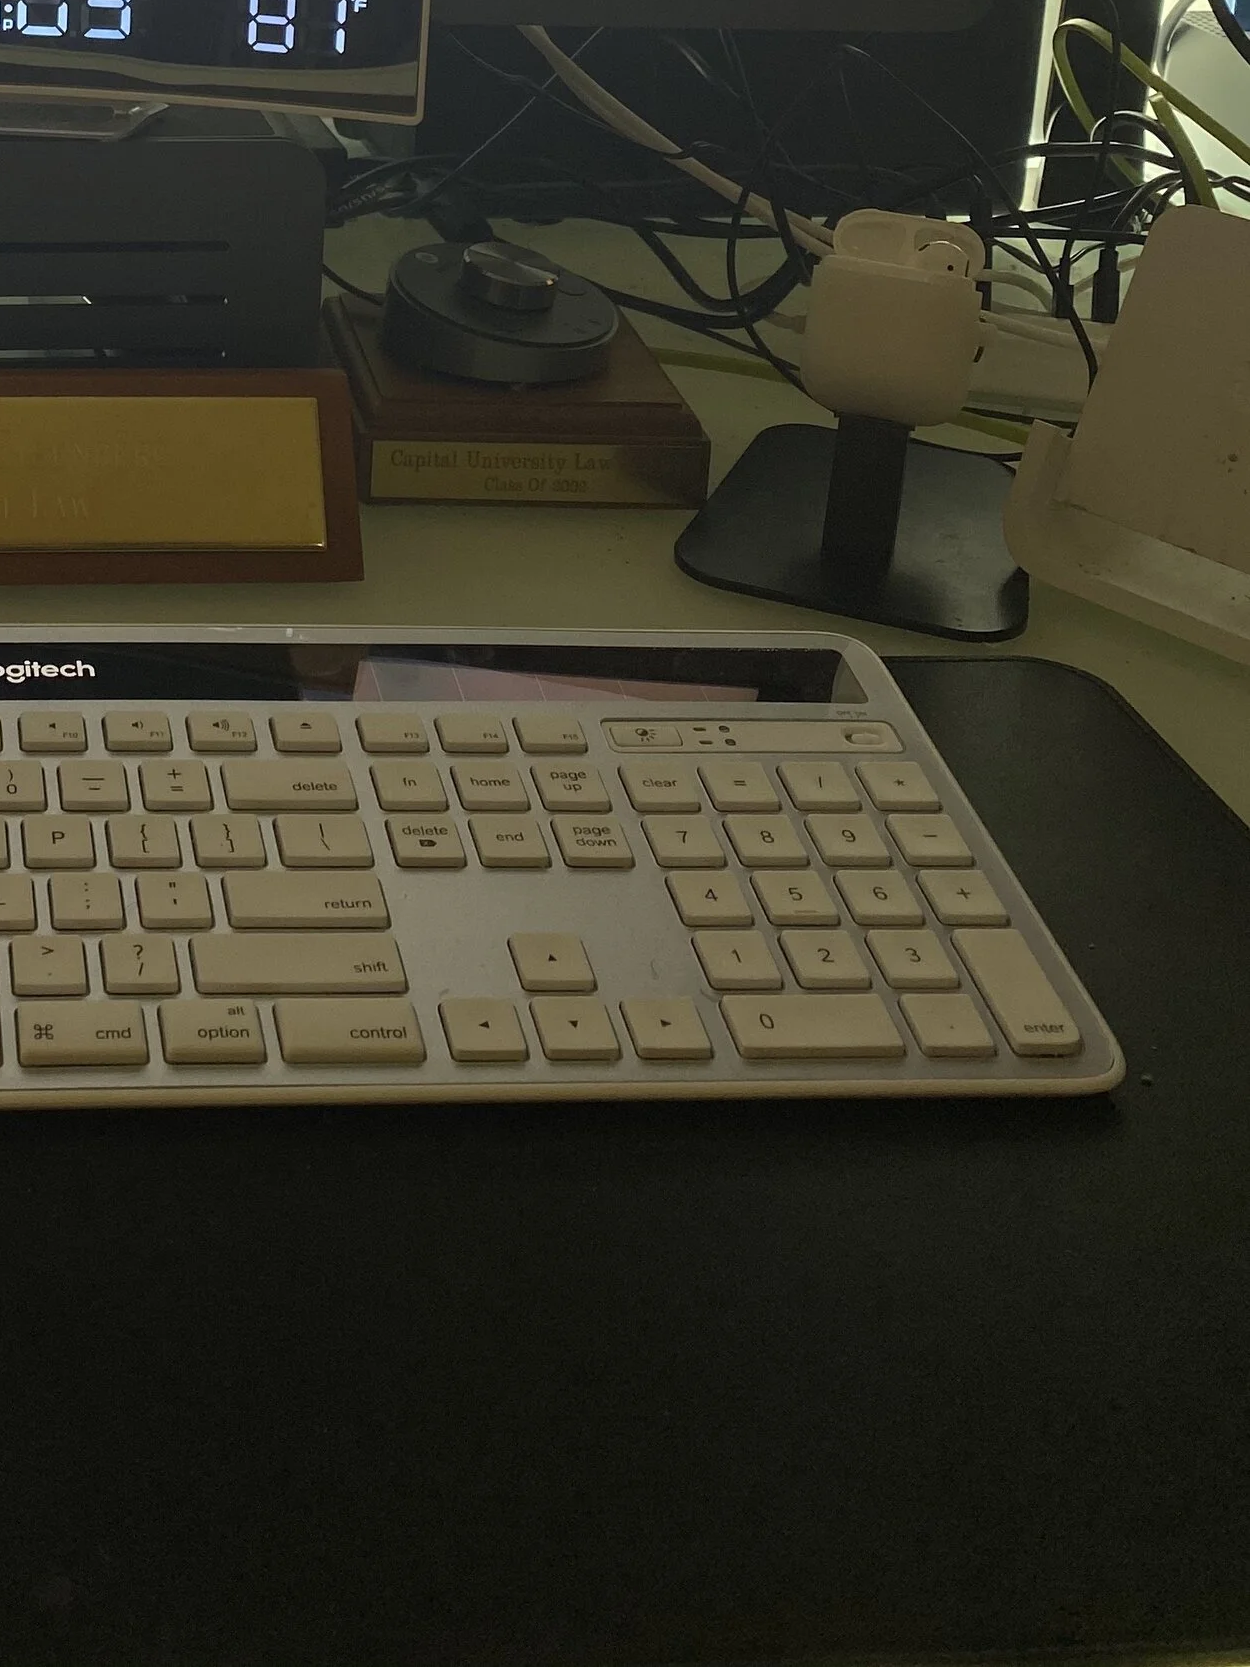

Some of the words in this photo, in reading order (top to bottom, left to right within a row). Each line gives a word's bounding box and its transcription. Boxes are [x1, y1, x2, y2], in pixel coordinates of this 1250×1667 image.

[390, 449, 458, 473] Capital
[467, 451, 567, 473] University
[469, 776, 511, 788] home
[550, 770, 588, 783] page
[641, 777, 678, 789] clear
[292, 780, 338, 792] delete
[563, 782, 582, 794] up
[401, 824, 448, 837] delete
[495, 832, 524, 843] end
[324, 897, 372, 910] return
[353, 961, 388, 974] shift
[95, 1027, 132, 1040] cmd
[197, 1026, 250, 1042] option
[349, 1026, 407, 1040] control
[1023, 1022, 1065, 1034] enter
